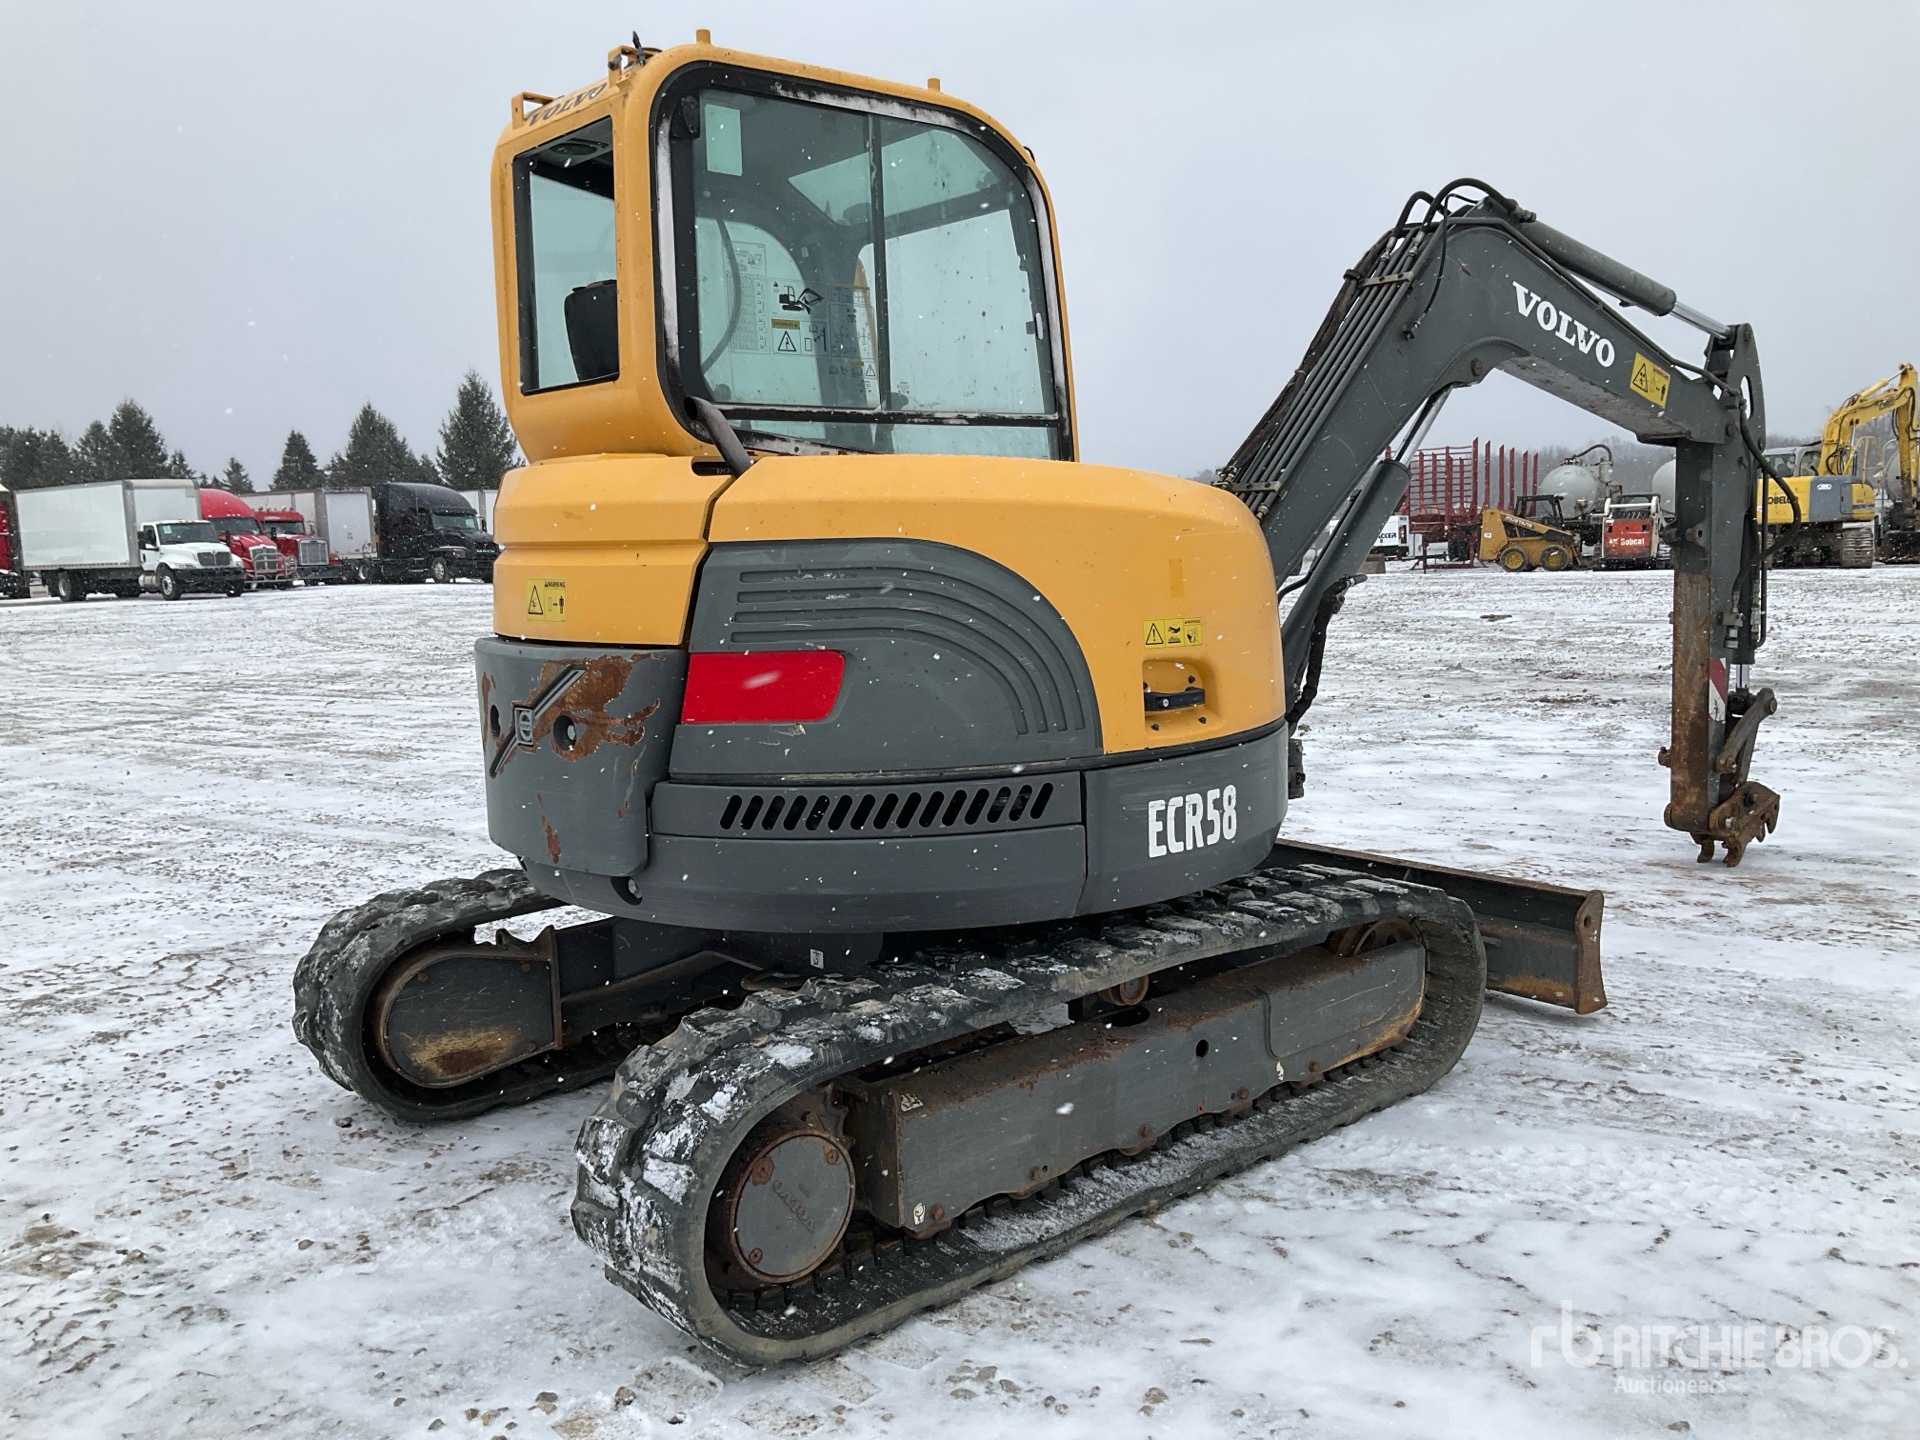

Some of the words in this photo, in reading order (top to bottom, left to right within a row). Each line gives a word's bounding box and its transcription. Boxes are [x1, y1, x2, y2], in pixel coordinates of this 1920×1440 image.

[529, 82, 608, 127] VOLVO
[1512, 281, 1616, 368] VOLVO
[1767, 495, 1793, 505] OBEL
[1620, 537, 1645, 546] Bobcat
[1148, 784, 1237, 858] ECR58
